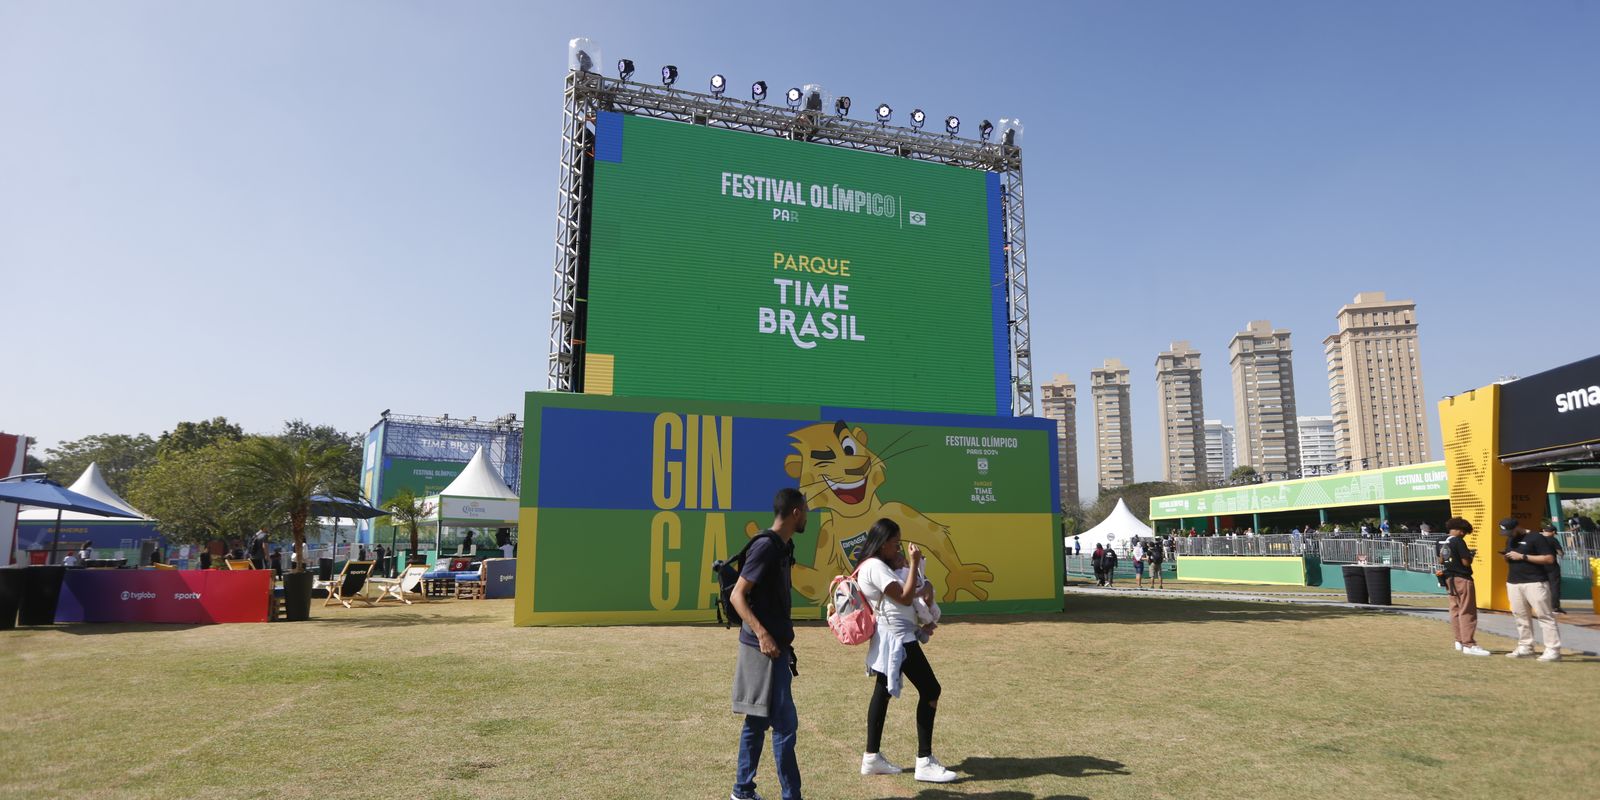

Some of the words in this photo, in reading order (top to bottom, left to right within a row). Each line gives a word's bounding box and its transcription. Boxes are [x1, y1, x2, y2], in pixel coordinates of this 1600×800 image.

[721, 172, 806, 206] FESTIVAL
[810, 184, 896, 219] OLÍMPICO
[773, 252, 851, 277] PARQUE
[773, 278, 849, 310] TIME
[759, 307, 865, 349] BRASIL
[421, 439, 446, 448] TIME
[945, 435, 981, 447] FESTIVAL
[981, 436, 1018, 448] OLÍMPICO
[652, 412, 733, 510] GIN
[1395, 473, 1424, 486] FESTIVAL
[971, 494, 997, 504] BRASIL
[130, 591, 156, 600] tvglobo
[174, 591, 201, 600] sportv
